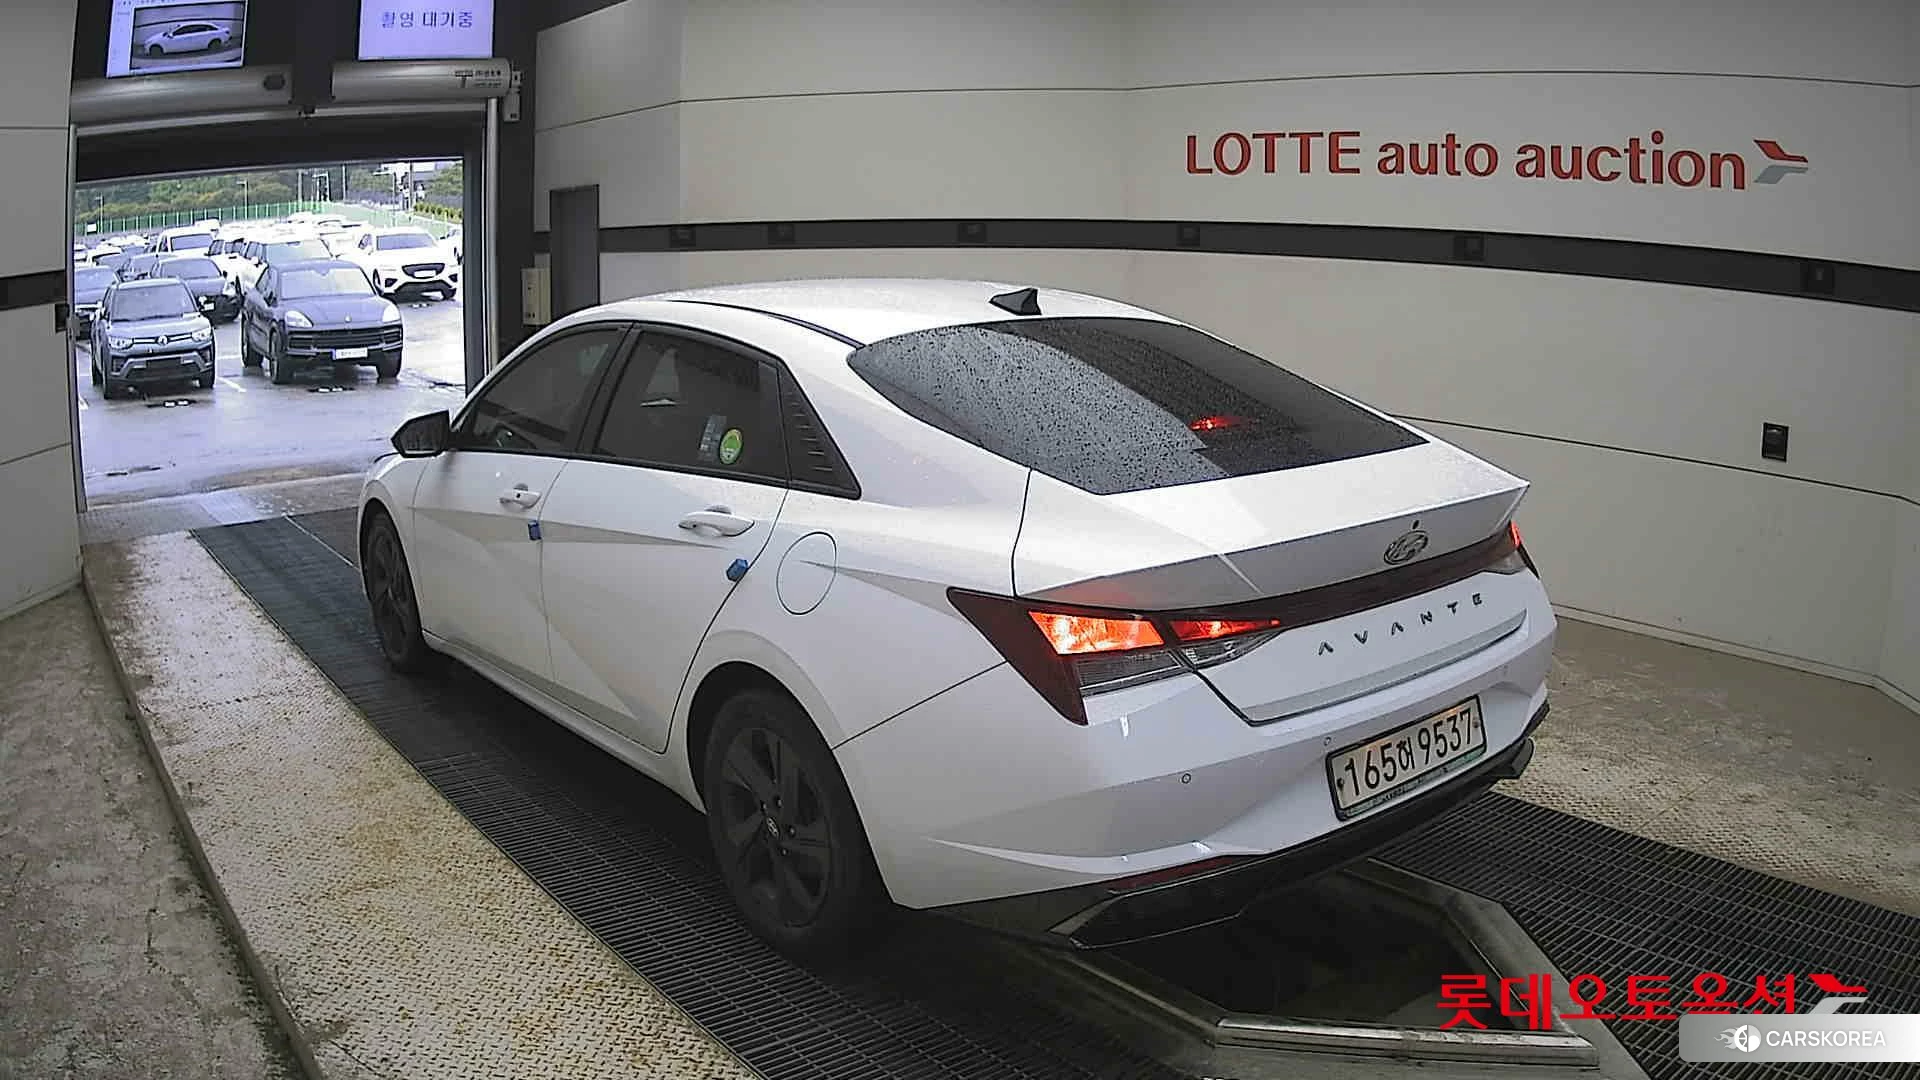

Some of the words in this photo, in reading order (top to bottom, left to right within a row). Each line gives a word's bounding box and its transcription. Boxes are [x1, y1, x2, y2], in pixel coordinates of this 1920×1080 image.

[422, 11, 473, 29] 대기중
[1186, 131, 1361, 175] LOTTE
[1377, 133, 1499, 177] auto
[1514, 130, 1746, 190] auction
[1317, 592, 1483, 656] AVANTE
[1344, 737, 1416, 797] 165허
[1417, 707, 1472, 766] 9537
